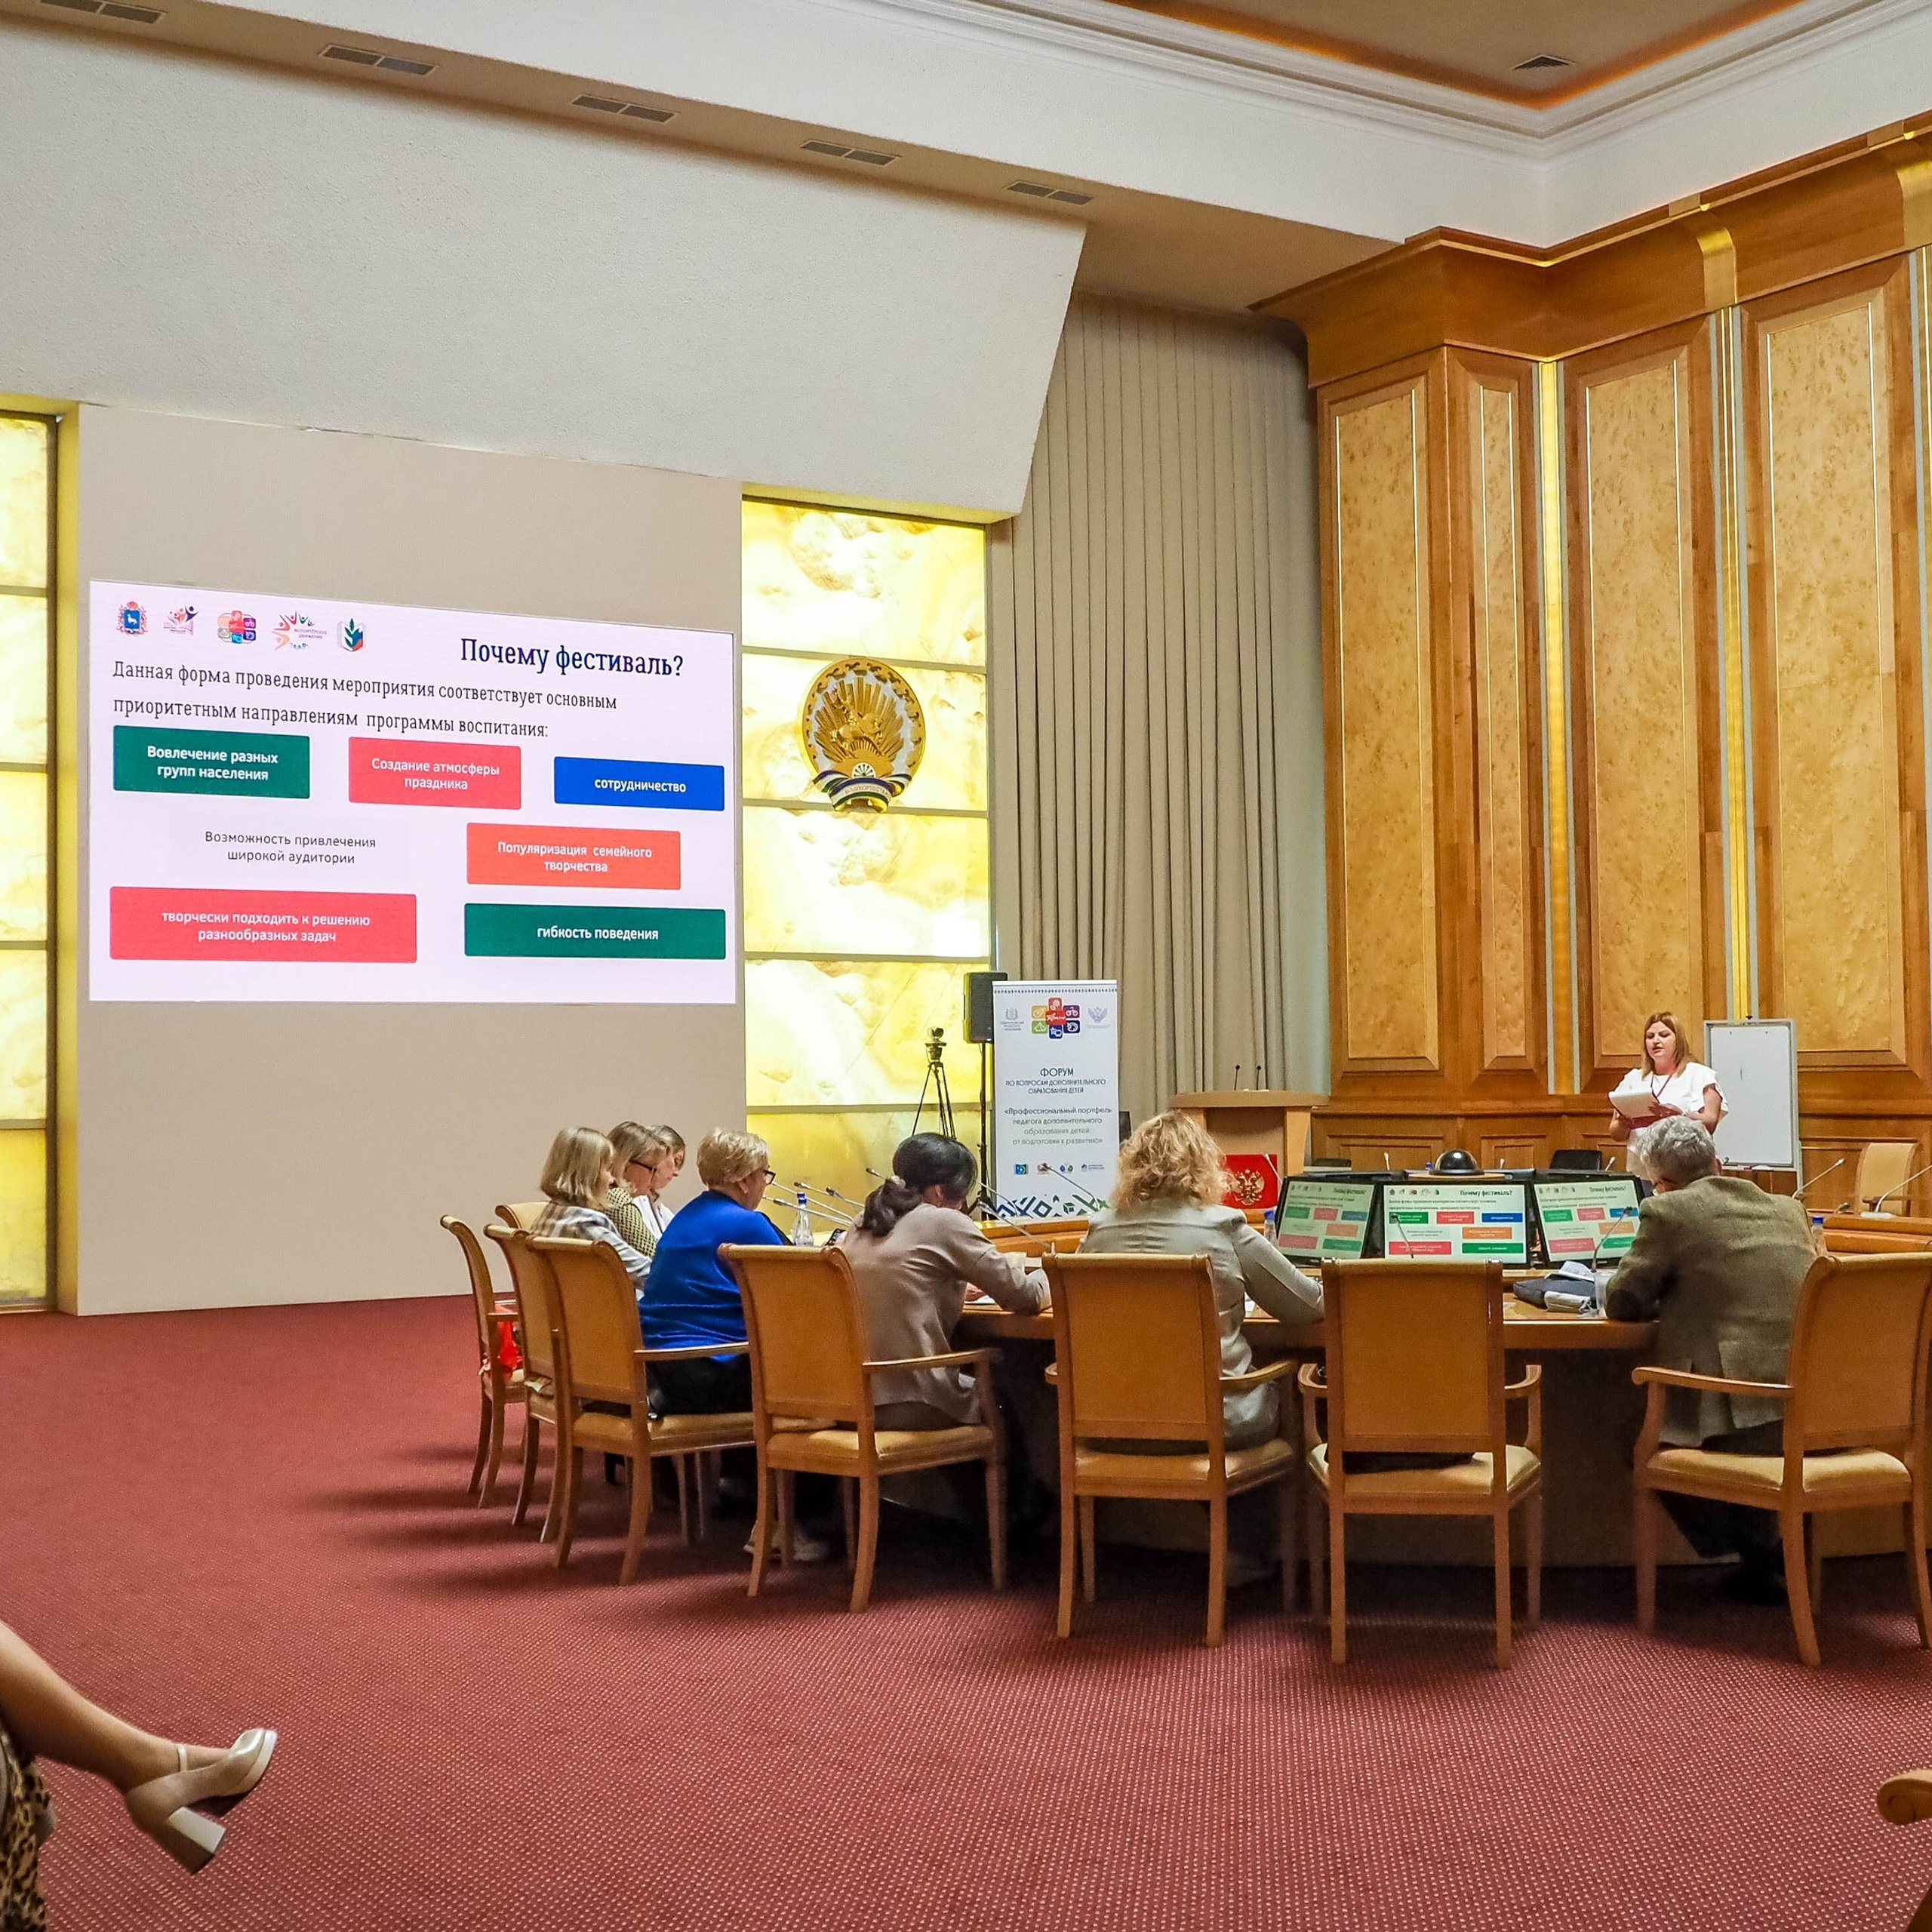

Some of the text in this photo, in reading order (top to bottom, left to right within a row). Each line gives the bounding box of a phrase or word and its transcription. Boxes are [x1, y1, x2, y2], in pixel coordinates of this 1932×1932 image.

[460, 638, 684, 677] Почему фестиваль?
[112, 660, 617, 709] Данная форма проведения мероприятия соответствует основным
[113, 697, 549, 737] приоритетным направлениям программы воспитания:
[147, 745, 278, 765] Вовлечение разных
[157, 765, 269, 781] групп населения
[371, 758, 500, 777] Создание атмосферы
[404, 777, 468, 790] праздника
[594, 778, 687, 793] сотрудничество
[205, 831, 377, 848] Возможность привлечения
[227, 849, 355, 865] широкой аудитории
[497, 841, 652, 859] Популяризация семейного
[544, 860, 608, 872] творчества
[161, 912, 371, 928] творчески подходить к решению
[198, 928, 337, 943] разнообразных задач
[537, 925, 659, 940] гибкость поведения
[1040, 1067, 1074, 1077] ФОРУМ
[1049, 1078, 1106, 1087] ДОПОЛНИТЕЛЬНОГО
[1004, 1107, 1077, 1115] «Профессиональный
[1023, 1127, 1069, 1135] образования
